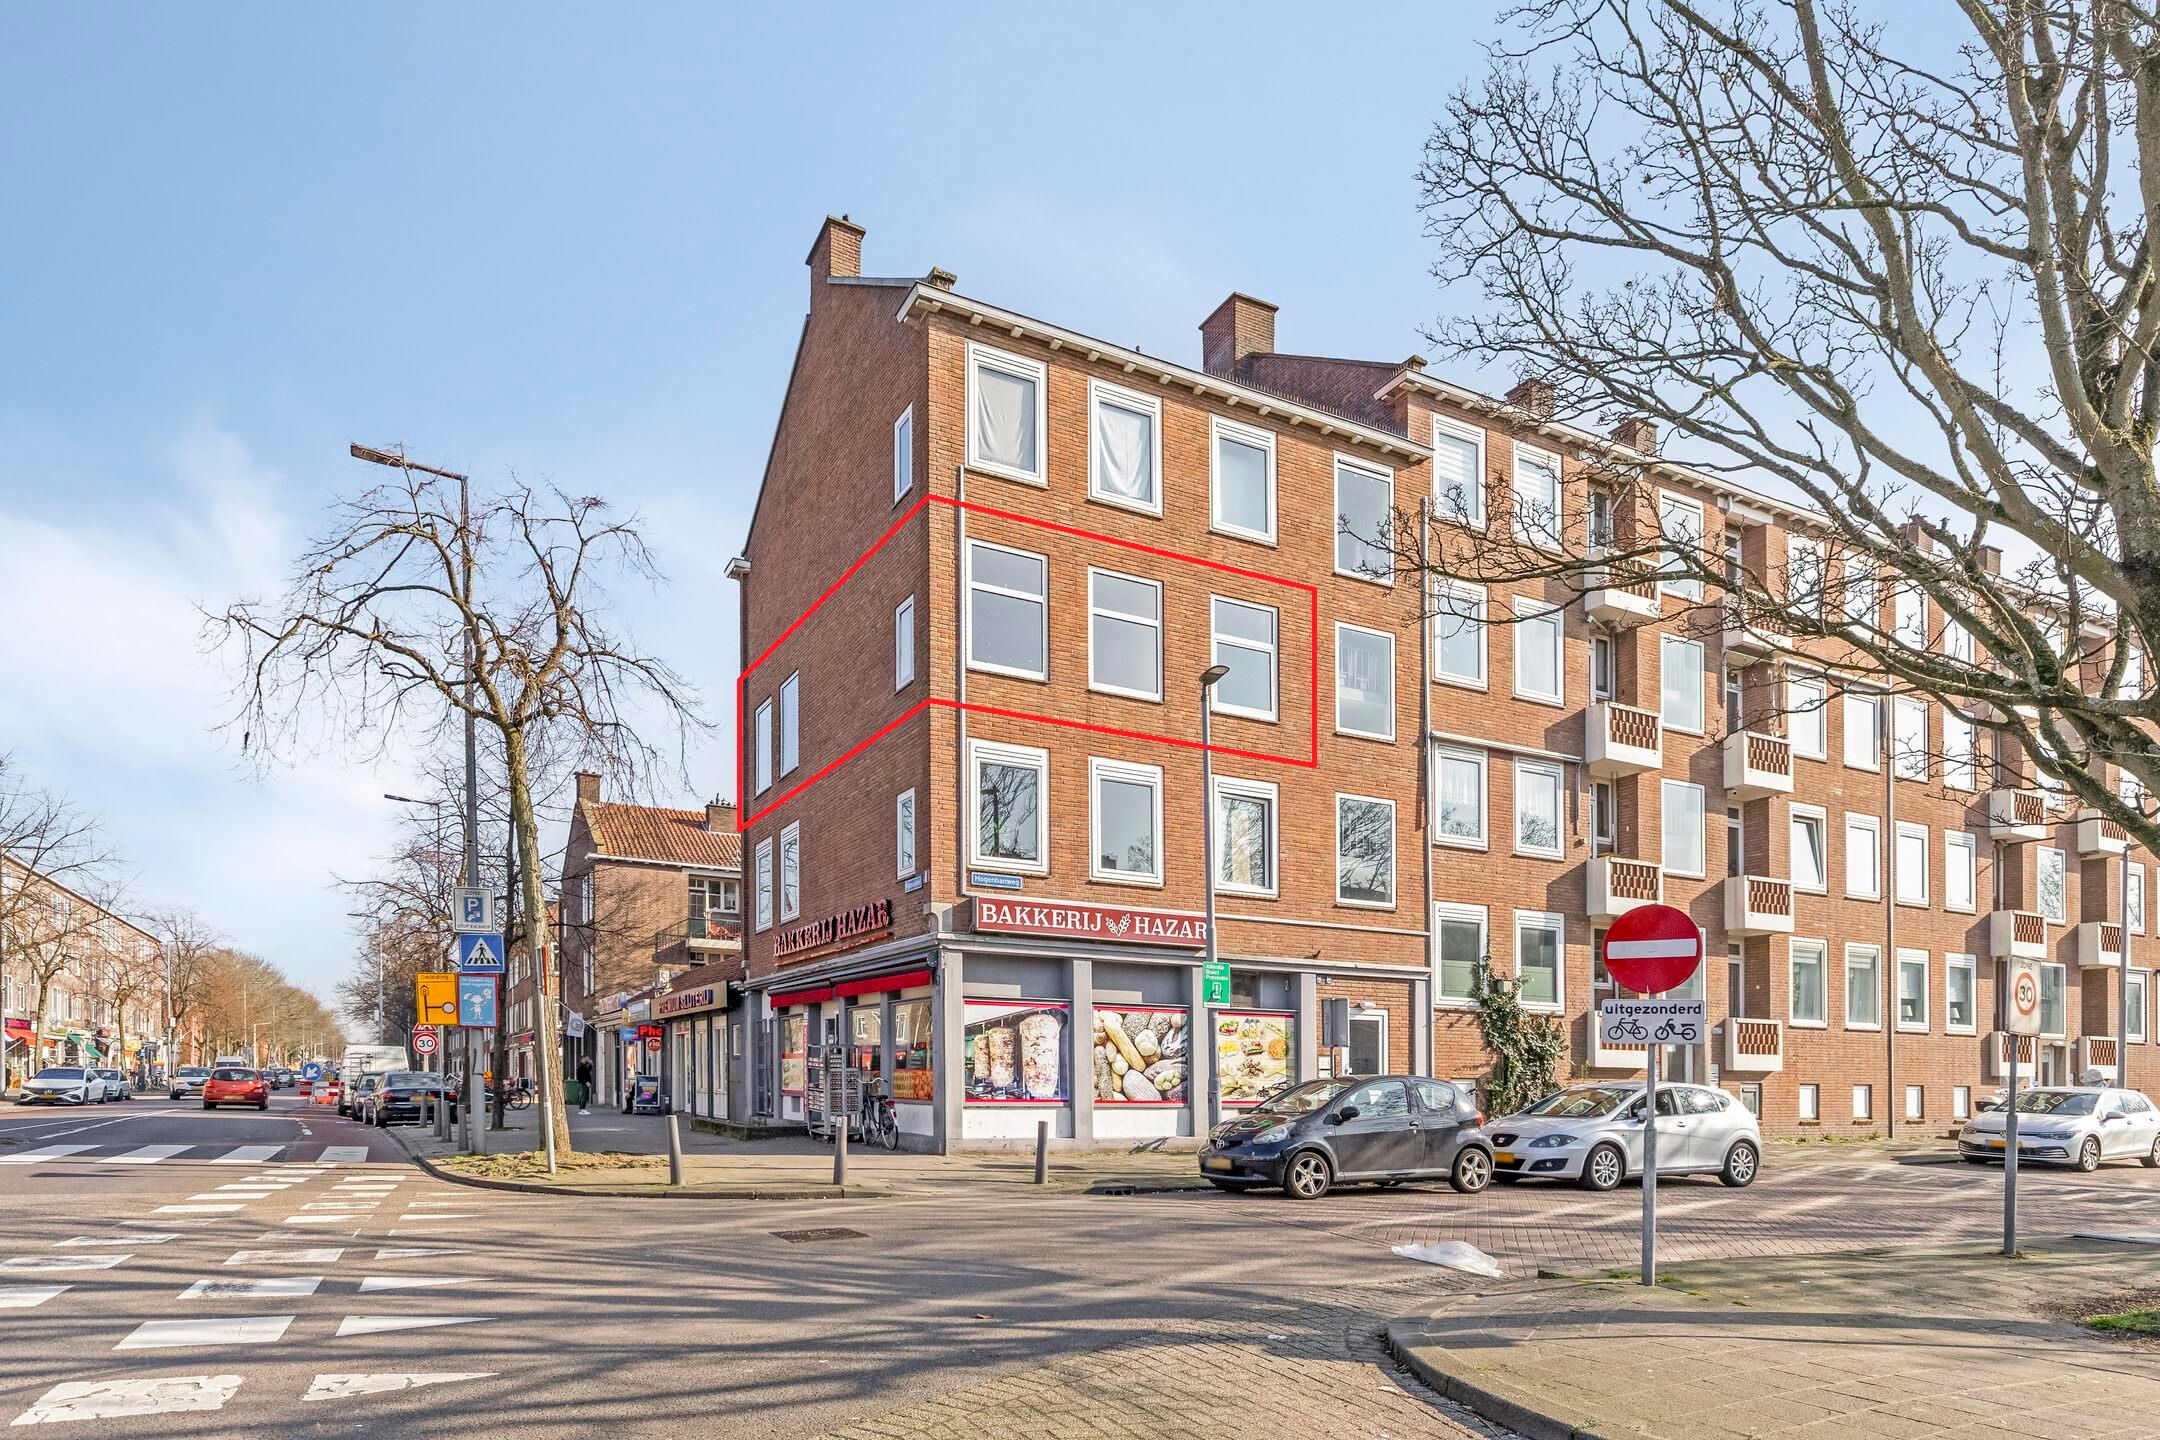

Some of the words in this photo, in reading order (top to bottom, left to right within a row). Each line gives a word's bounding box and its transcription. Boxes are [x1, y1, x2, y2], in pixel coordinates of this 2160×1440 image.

[773, 916, 833, 957] BAKKERIJ
[835, 899, 889, 941] HAZAR
[981, 903, 1103, 931] BAKKERIJ
[1133, 916, 1207, 940] HAZAR
[2020, 961, 2033, 970] ZONE
[2019, 985, 2033, 1003] 30
[1605, 1004, 1701, 1017] uitgezonderd
[419, 1039, 434, 1048] 30
